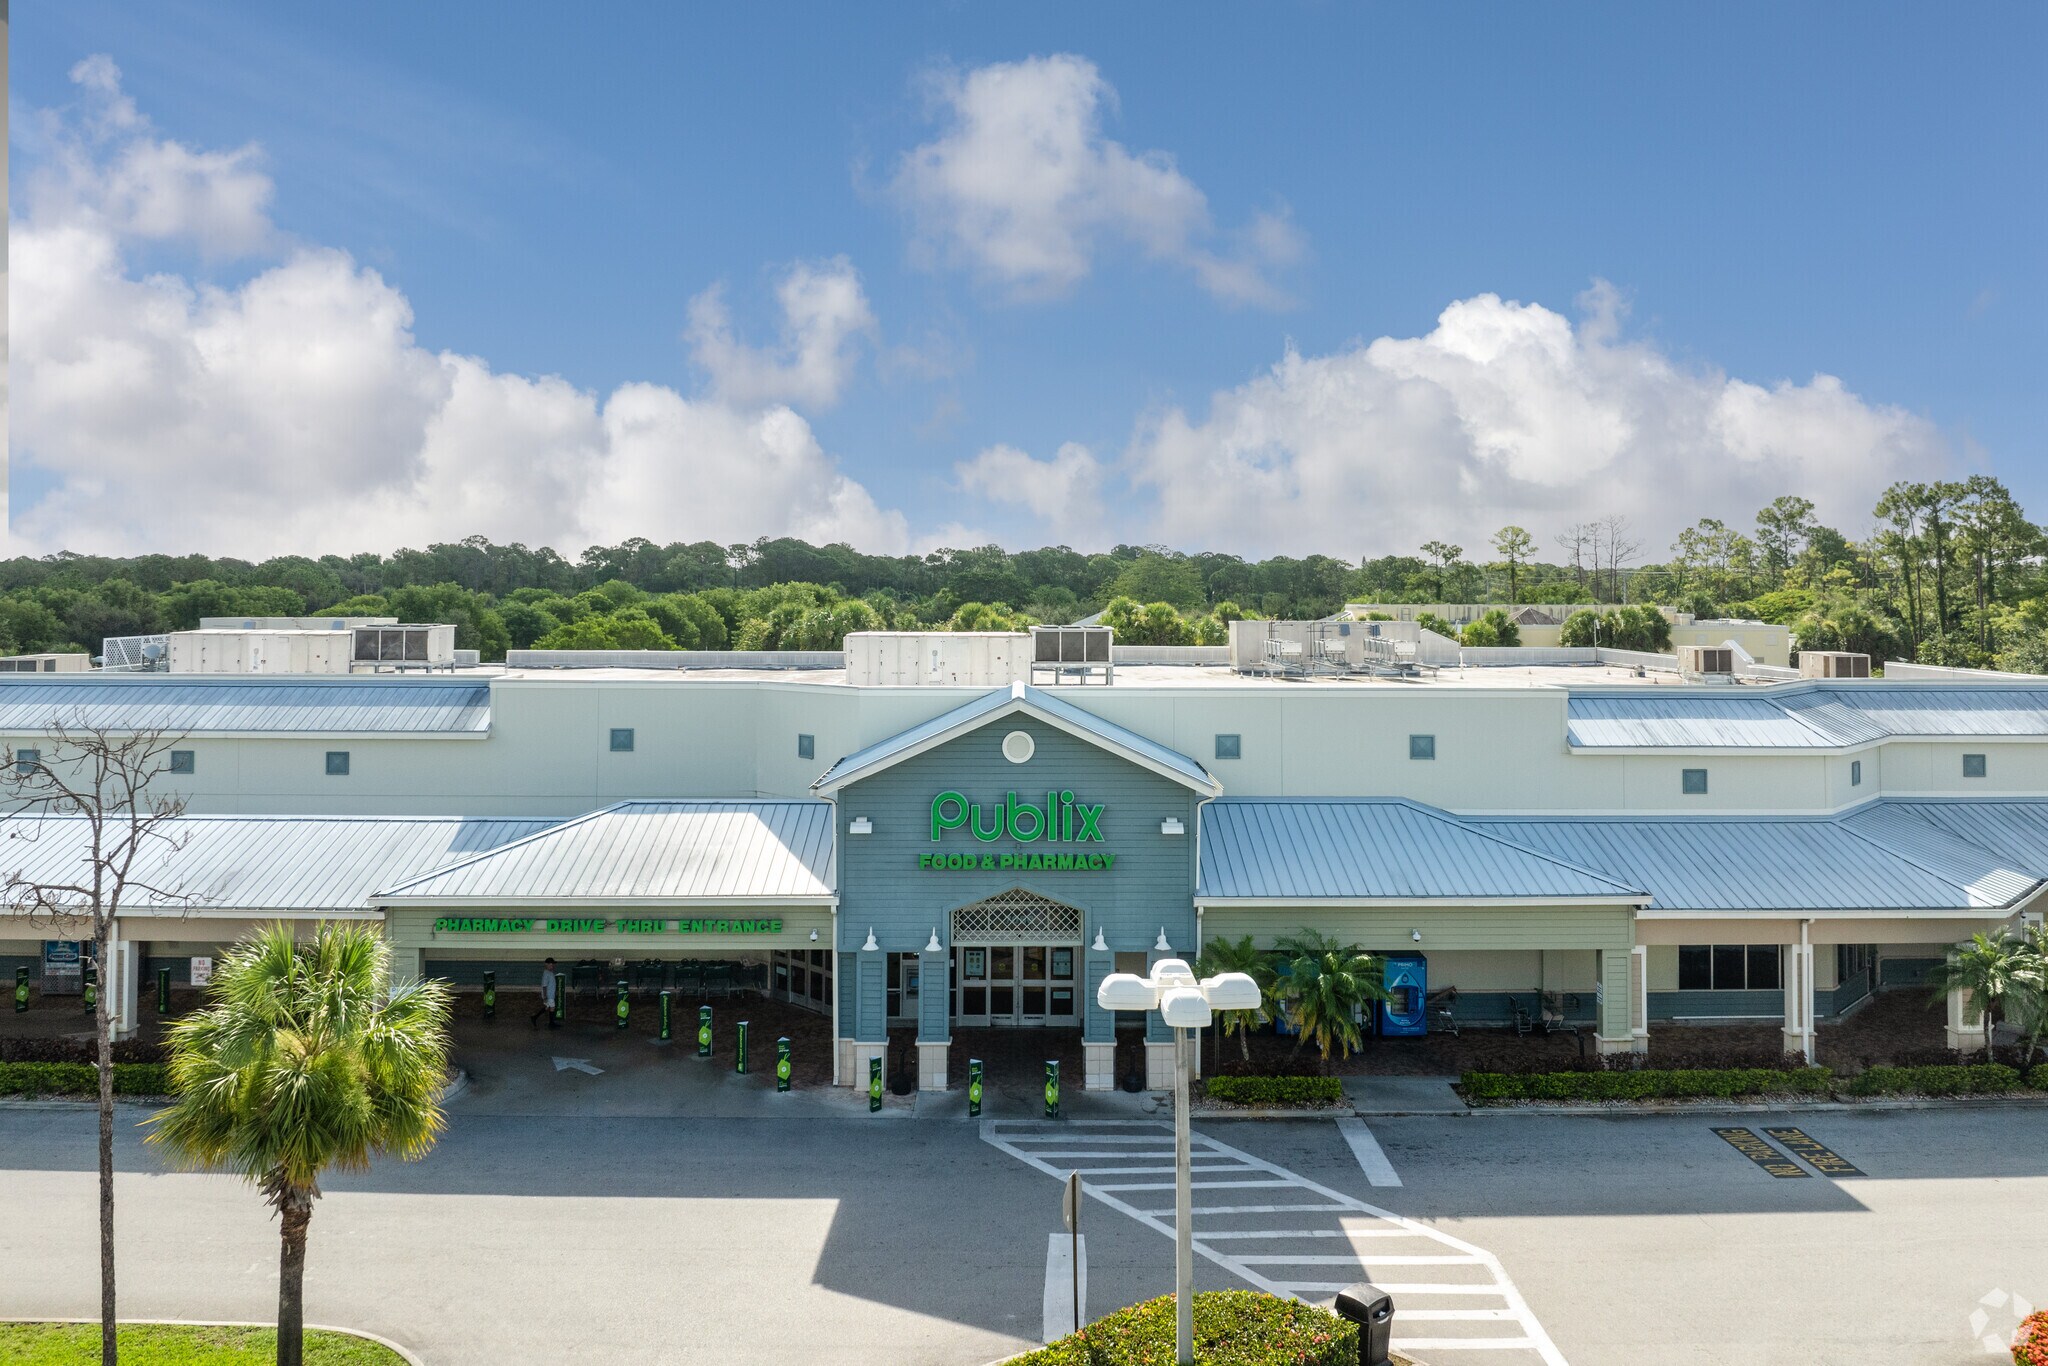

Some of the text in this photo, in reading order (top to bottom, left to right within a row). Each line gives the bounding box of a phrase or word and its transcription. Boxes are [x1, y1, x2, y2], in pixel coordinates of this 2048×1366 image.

[930, 790, 1105, 842] Publix
[919, 854, 1115, 871] FOOD & PHARMACY
[435, 917, 783, 934] PHARMACY DRIVE THRU ENTRANCE
[1718, 1129, 1806, 1176] NO PARKING
[1767, 1129, 1856, 1173] FIRE LANE
